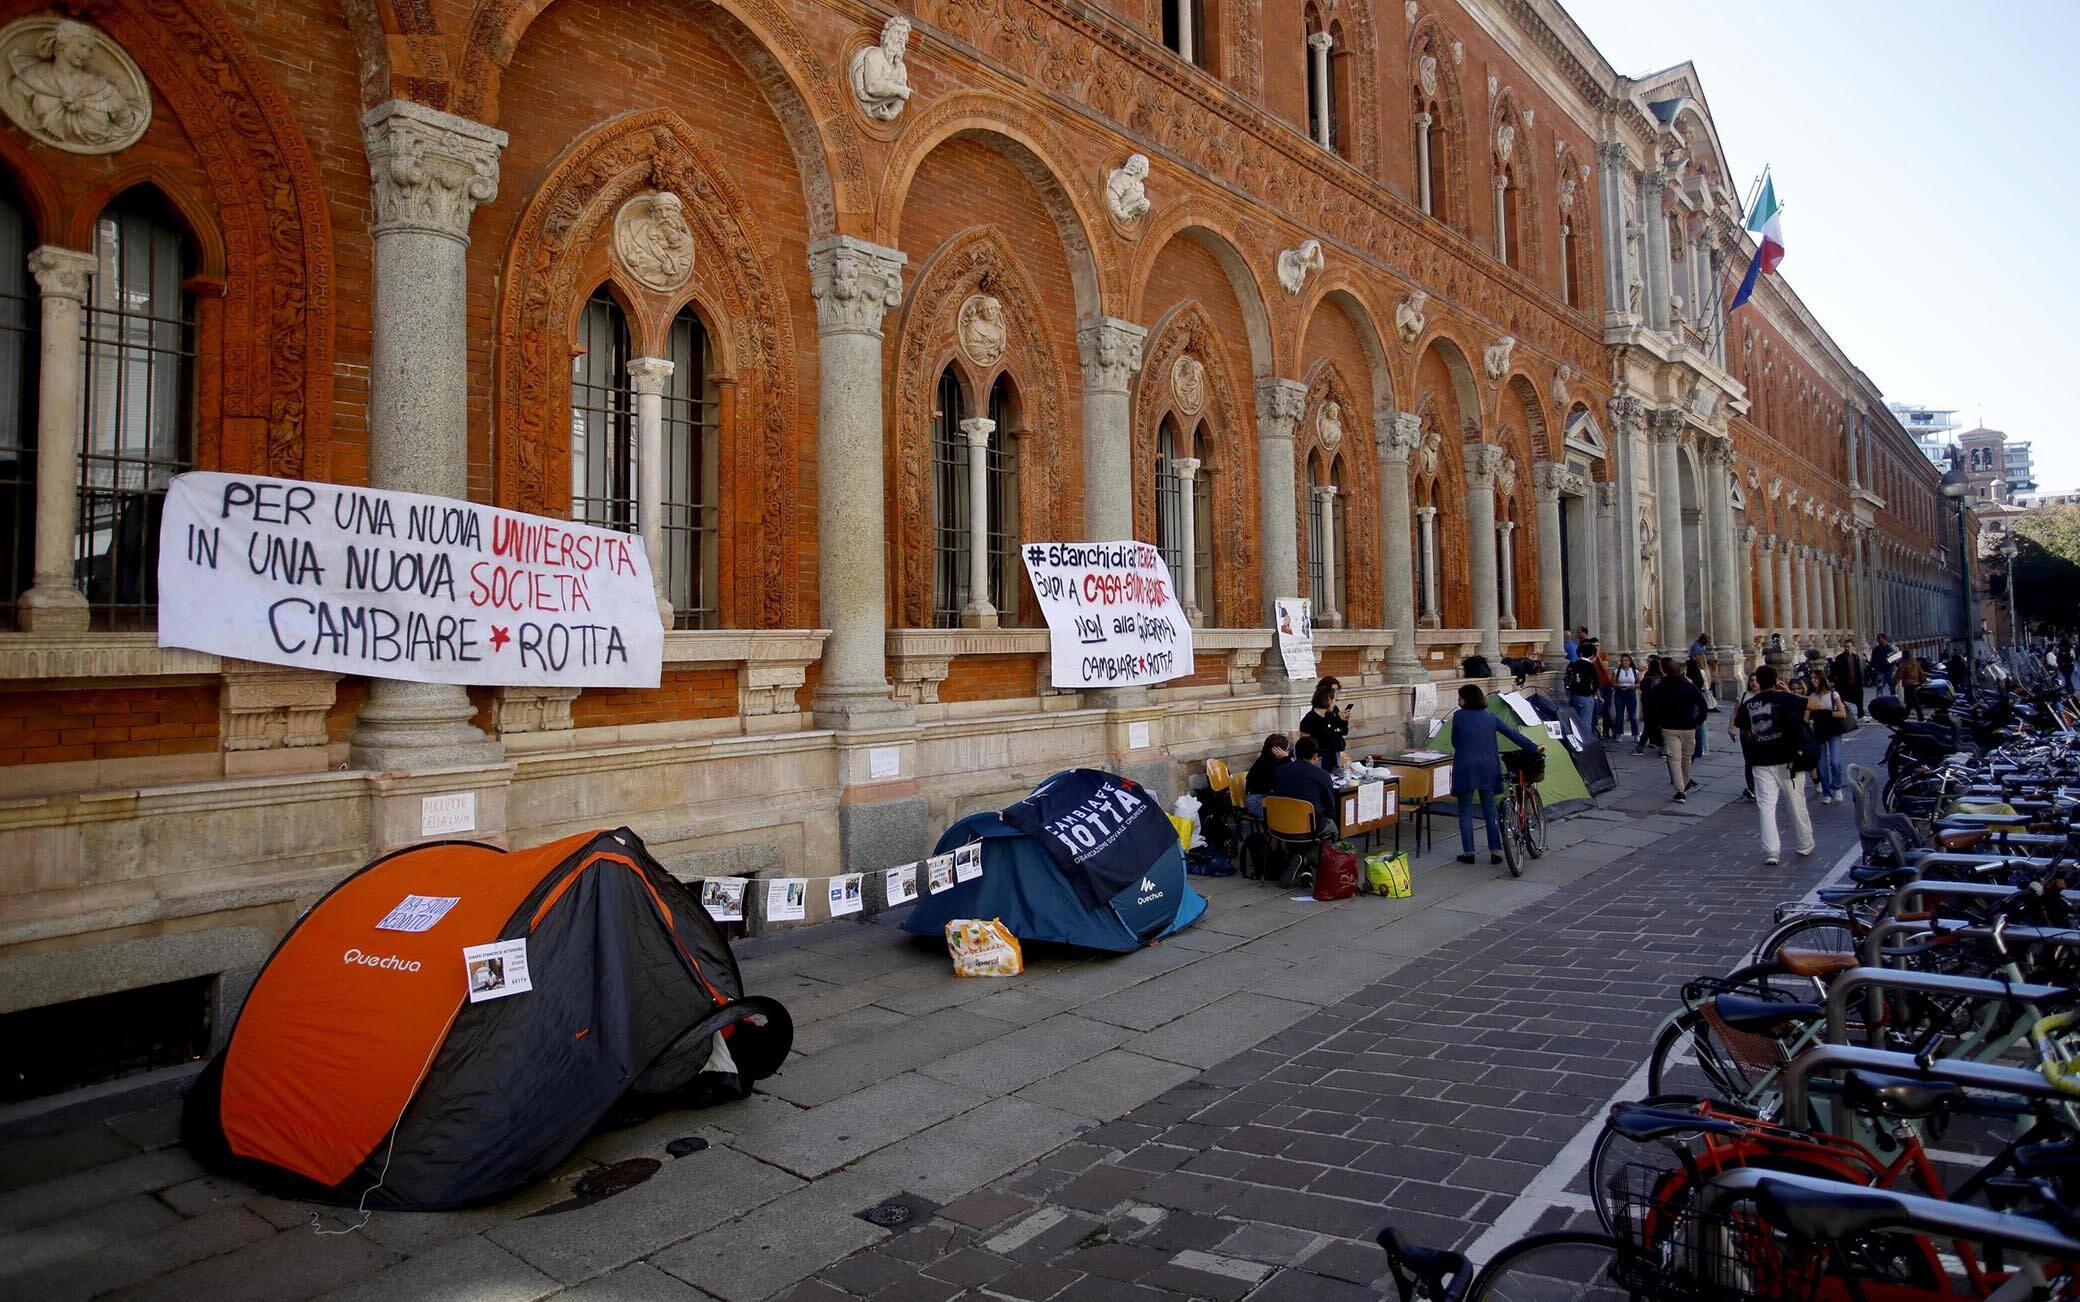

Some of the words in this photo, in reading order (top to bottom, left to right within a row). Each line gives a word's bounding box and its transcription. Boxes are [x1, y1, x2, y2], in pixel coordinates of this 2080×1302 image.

[221, 481, 318, 526] PER
[335, 491, 397, 540] UNA
[407, 504, 482, 553] NUOVA
[186, 523, 220, 570] IN
[248, 531, 325, 587] UNA
[345, 545, 456, 603] NUOVA
[1069, 578, 1081, 607] A
[268, 596, 483, 664] CAMBIARE
[519, 622, 628, 672] ROTTA
[1074, 613, 1106, 640] NON
[1112, 615, 1136, 634] alla
[1082, 653, 1140, 682] CAMBIARE
[1137, 891, 1164, 905] Quechua
[344, 948, 422, 972] Quechua
